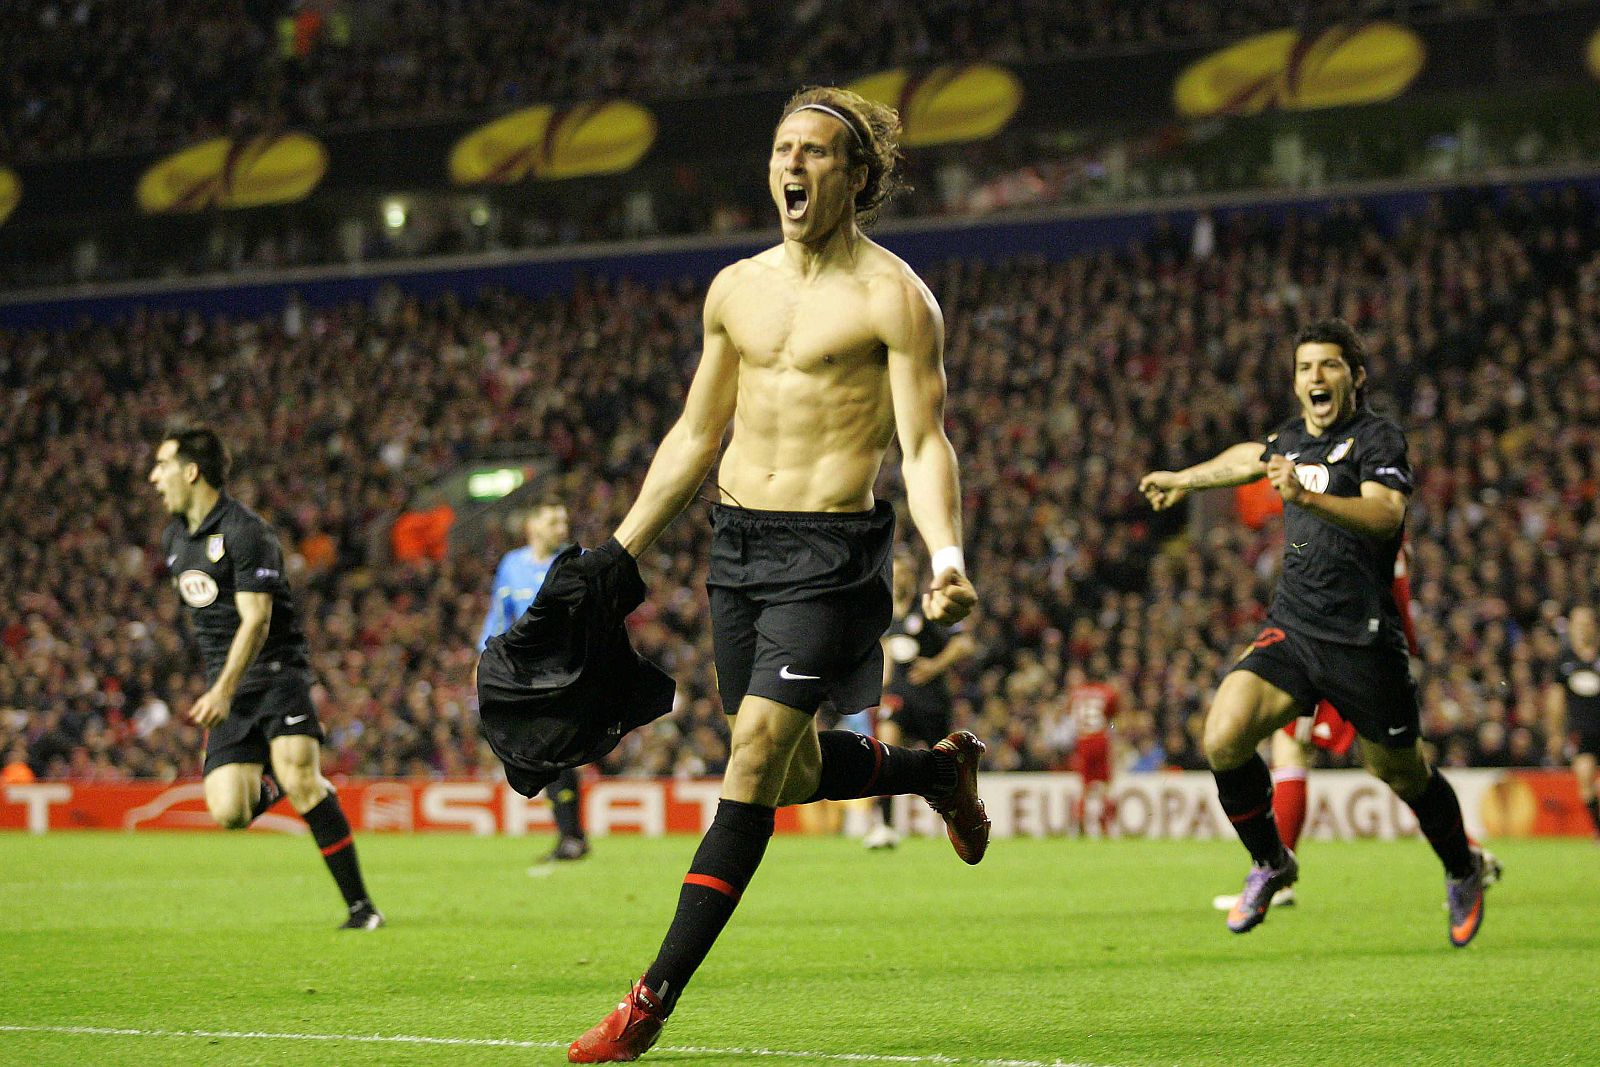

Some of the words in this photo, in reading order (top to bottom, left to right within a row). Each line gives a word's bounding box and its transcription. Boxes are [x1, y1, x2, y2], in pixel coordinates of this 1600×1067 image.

[184, 581, 212, 596] KIA
[422, 781, 722, 837] SEAT
[1009, 786, 1223, 838] EUOPA
